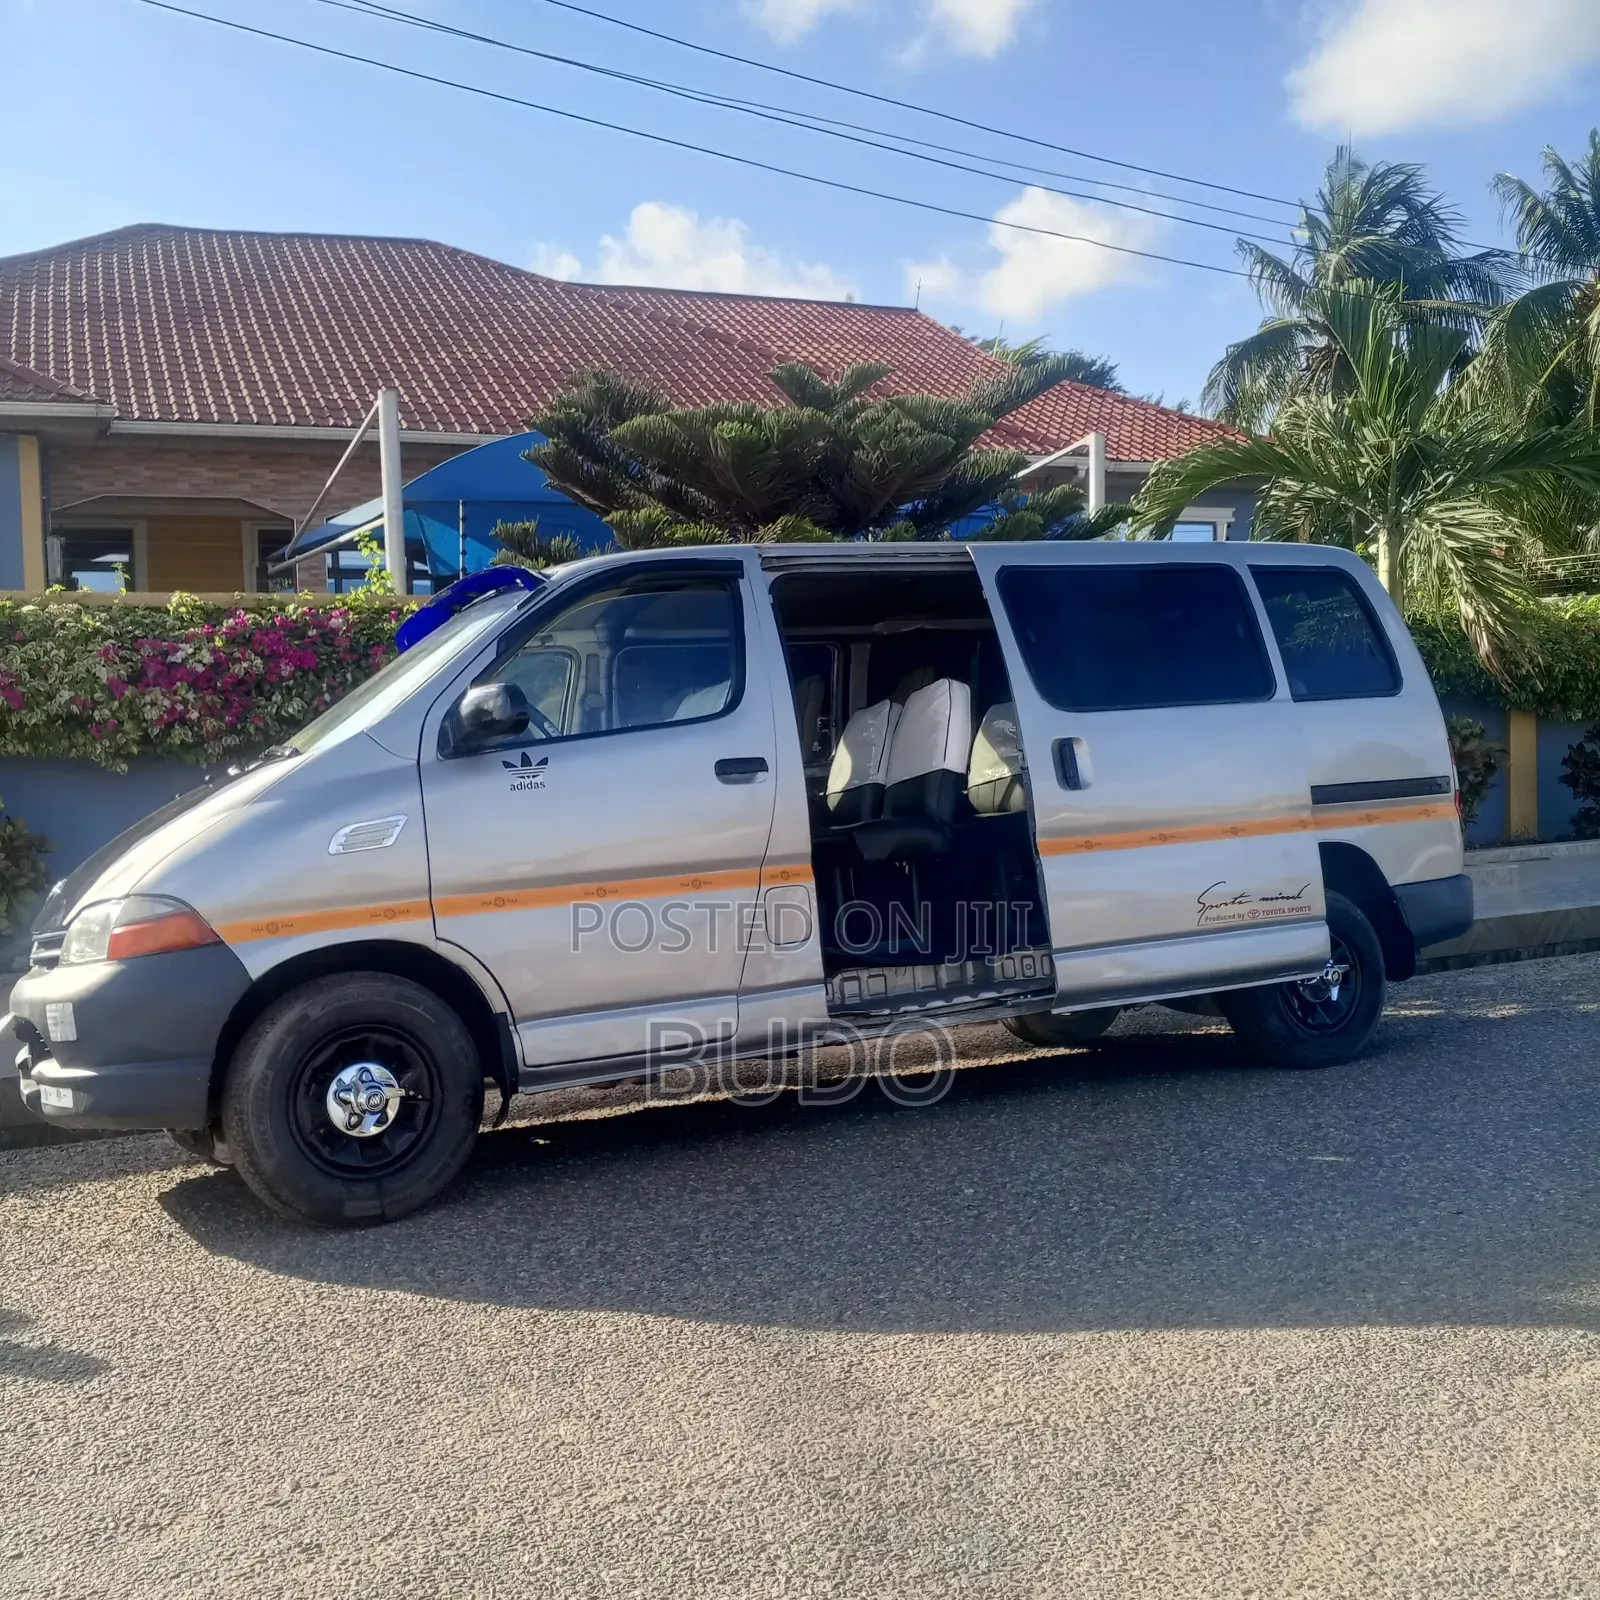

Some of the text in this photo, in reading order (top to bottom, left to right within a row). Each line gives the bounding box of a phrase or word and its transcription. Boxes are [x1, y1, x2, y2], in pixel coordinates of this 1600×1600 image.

[510, 780, 546, 792] adidas
[1197, 880, 1311, 926] Sports mind
[1204, 905, 1312, 923] Produced by TOYOTA SPORTS
